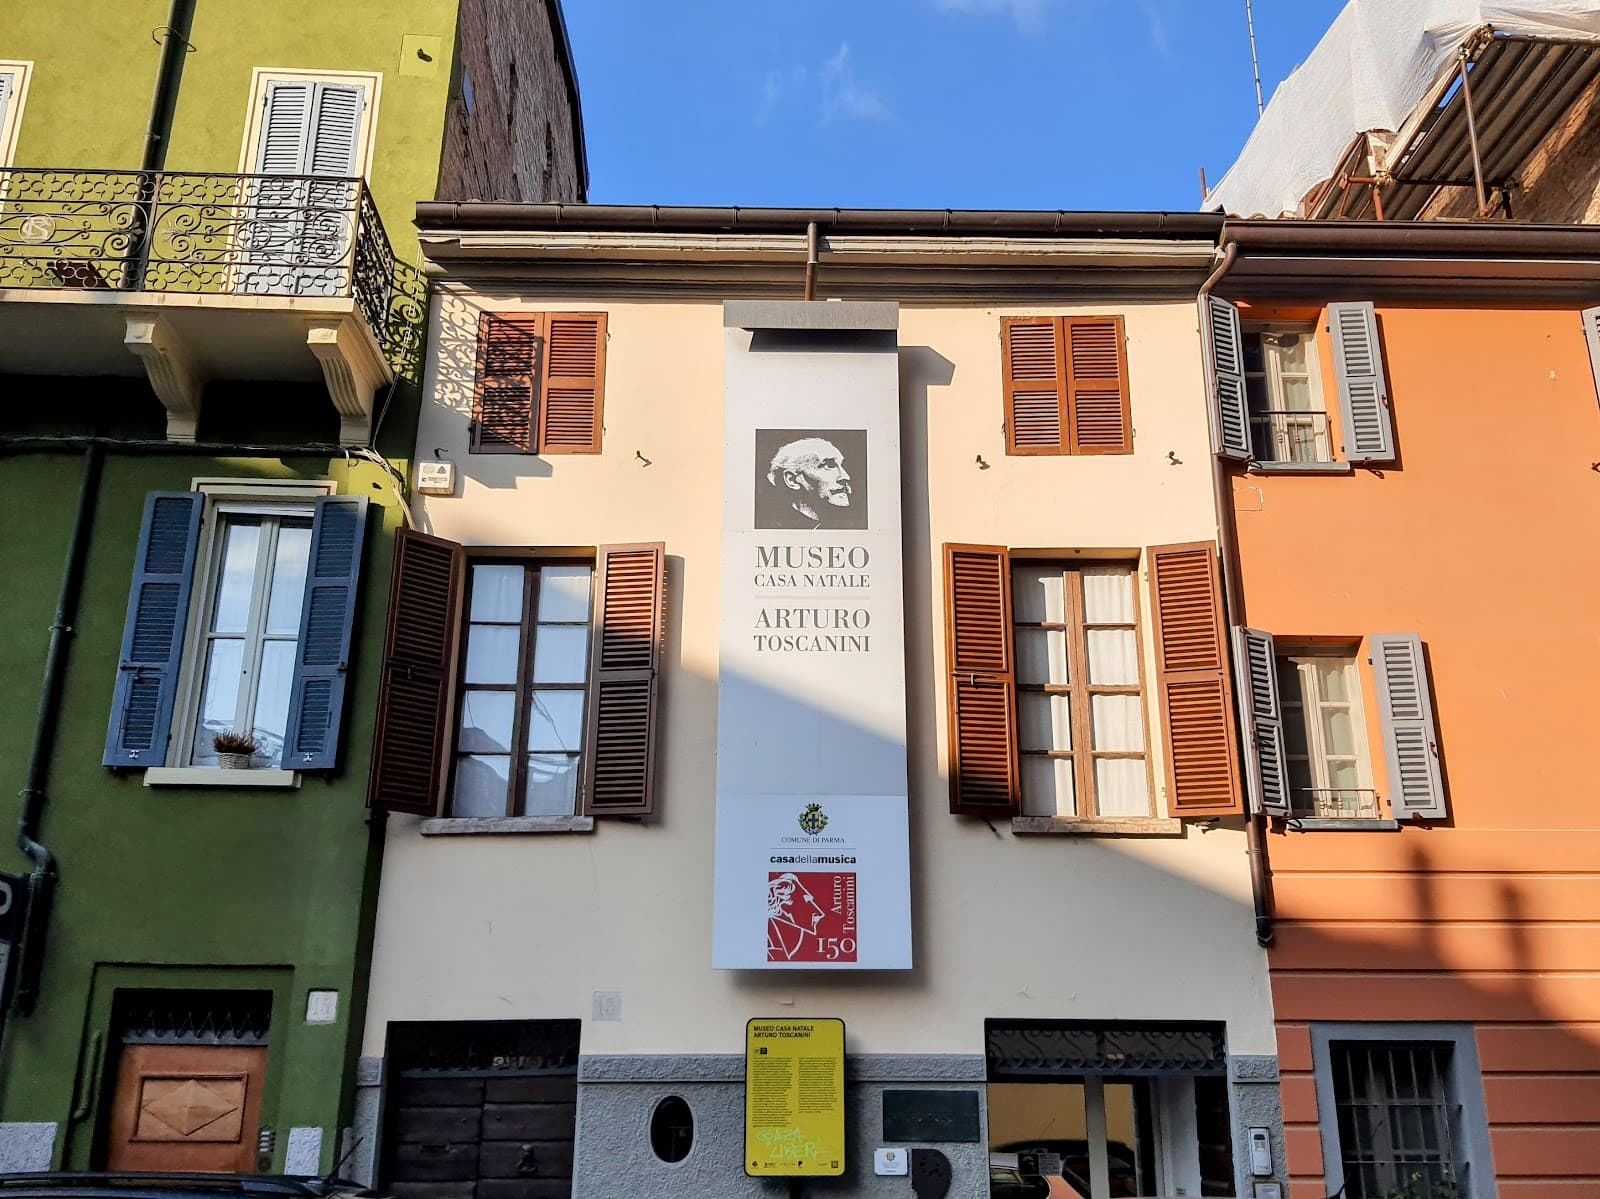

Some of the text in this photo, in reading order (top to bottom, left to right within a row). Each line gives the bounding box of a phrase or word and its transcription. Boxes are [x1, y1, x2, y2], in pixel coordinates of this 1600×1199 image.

[754, 545, 870, 569] MUSEO
[754, 574, 870, 588] CASA NATALE
[754, 608, 870, 629] ARTURO
[753, 634, 871, 653] TOSCANINI
[781, 836, 845, 844] COMUNE DI PARMA
[770, 854, 856, 865] casadellamusica
[830, 875, 842, 914] Arturo
[842, 876, 855, 935] Toscanini
[816, 937, 856, 960] 150
